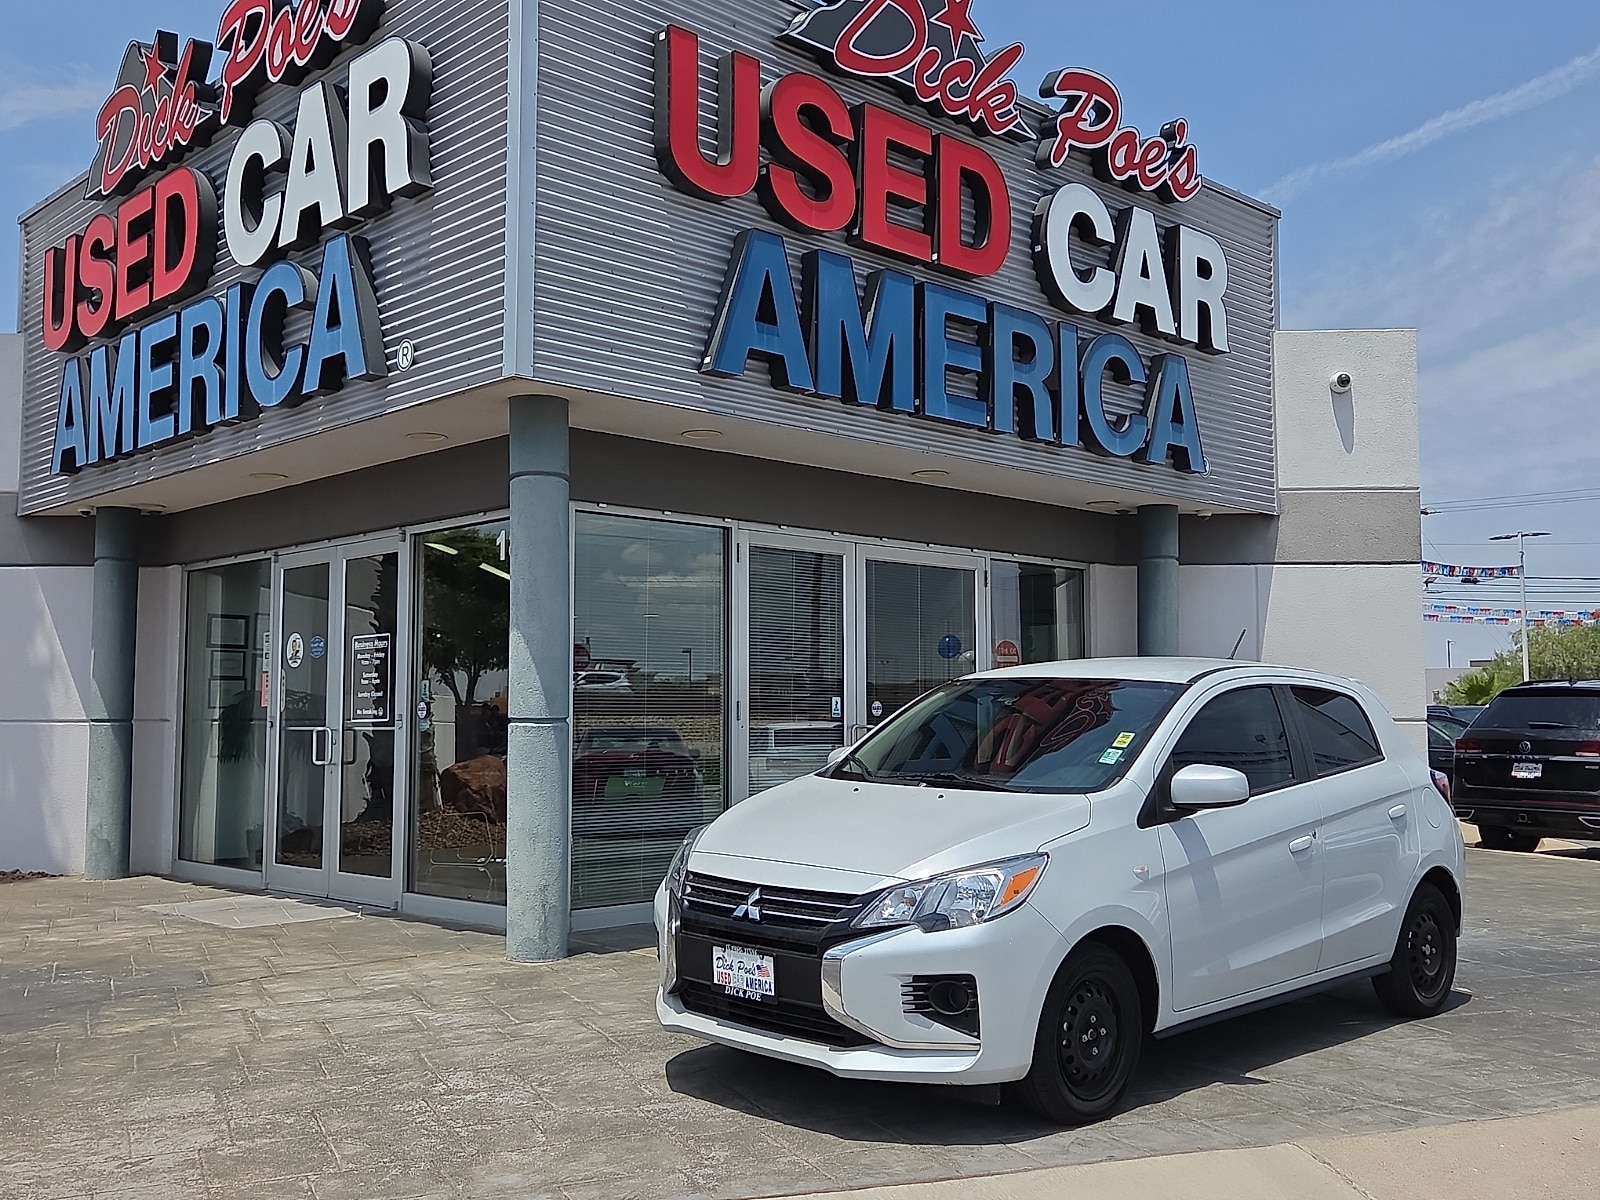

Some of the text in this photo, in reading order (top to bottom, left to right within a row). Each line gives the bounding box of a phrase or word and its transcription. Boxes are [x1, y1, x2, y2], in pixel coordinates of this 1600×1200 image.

[43, 37, 411, 352] USED CAR
[95, 0, 362, 196] Dick Poes
[667, 24, 1231, 355] USED CAR
[834, 0, 1203, 202] Dick Poe's
[50, 233, 368, 476] AMERICA
[711, 228, 1206, 473] AMERICA
[716, 956, 756, 976] Dick Poe's
[716, 970, 732, 985] USED
[746, 976, 772, 994] AMERICA
[724, 986, 762, 1002] DICK POE
